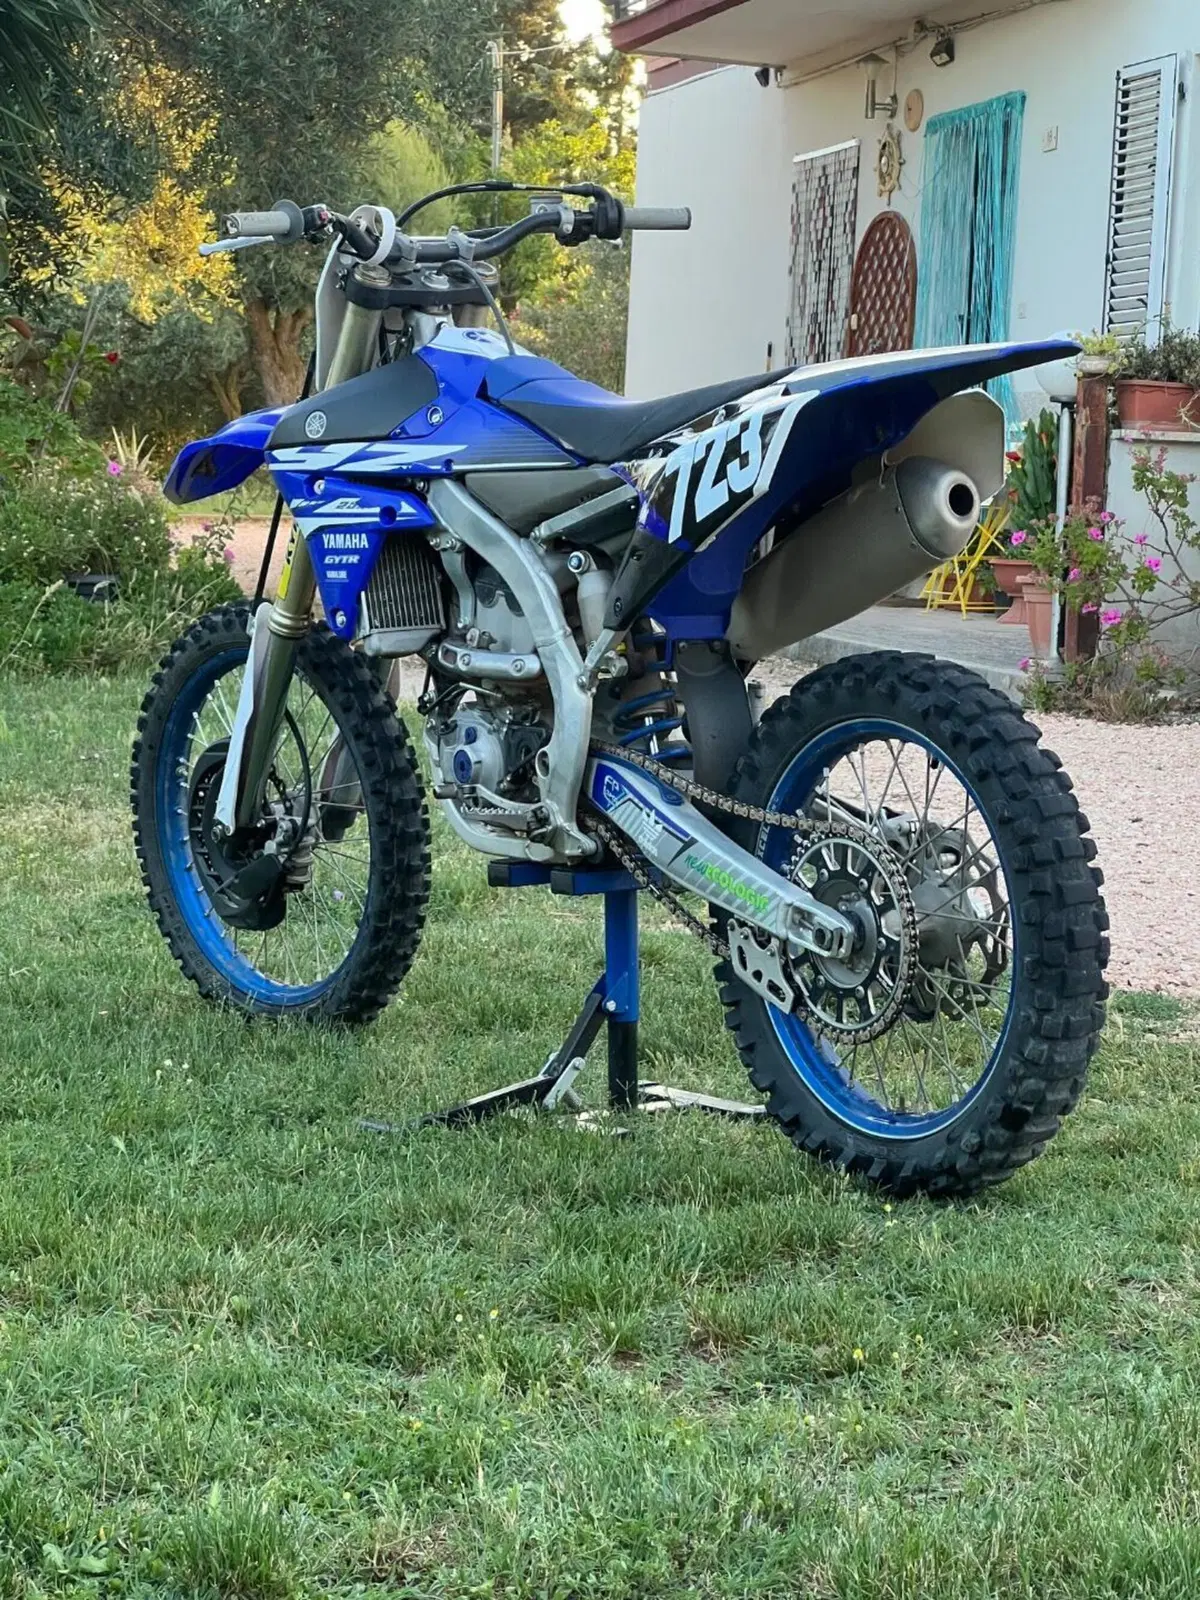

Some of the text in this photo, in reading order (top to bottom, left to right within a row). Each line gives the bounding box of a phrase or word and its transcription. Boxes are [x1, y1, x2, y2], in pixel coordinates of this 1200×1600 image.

[664, 411, 764, 544] 723
[322, 533, 369, 549] YAMAHA
[323, 555, 360, 565] GYTR
[757, 823, 771, 860] XCEL
